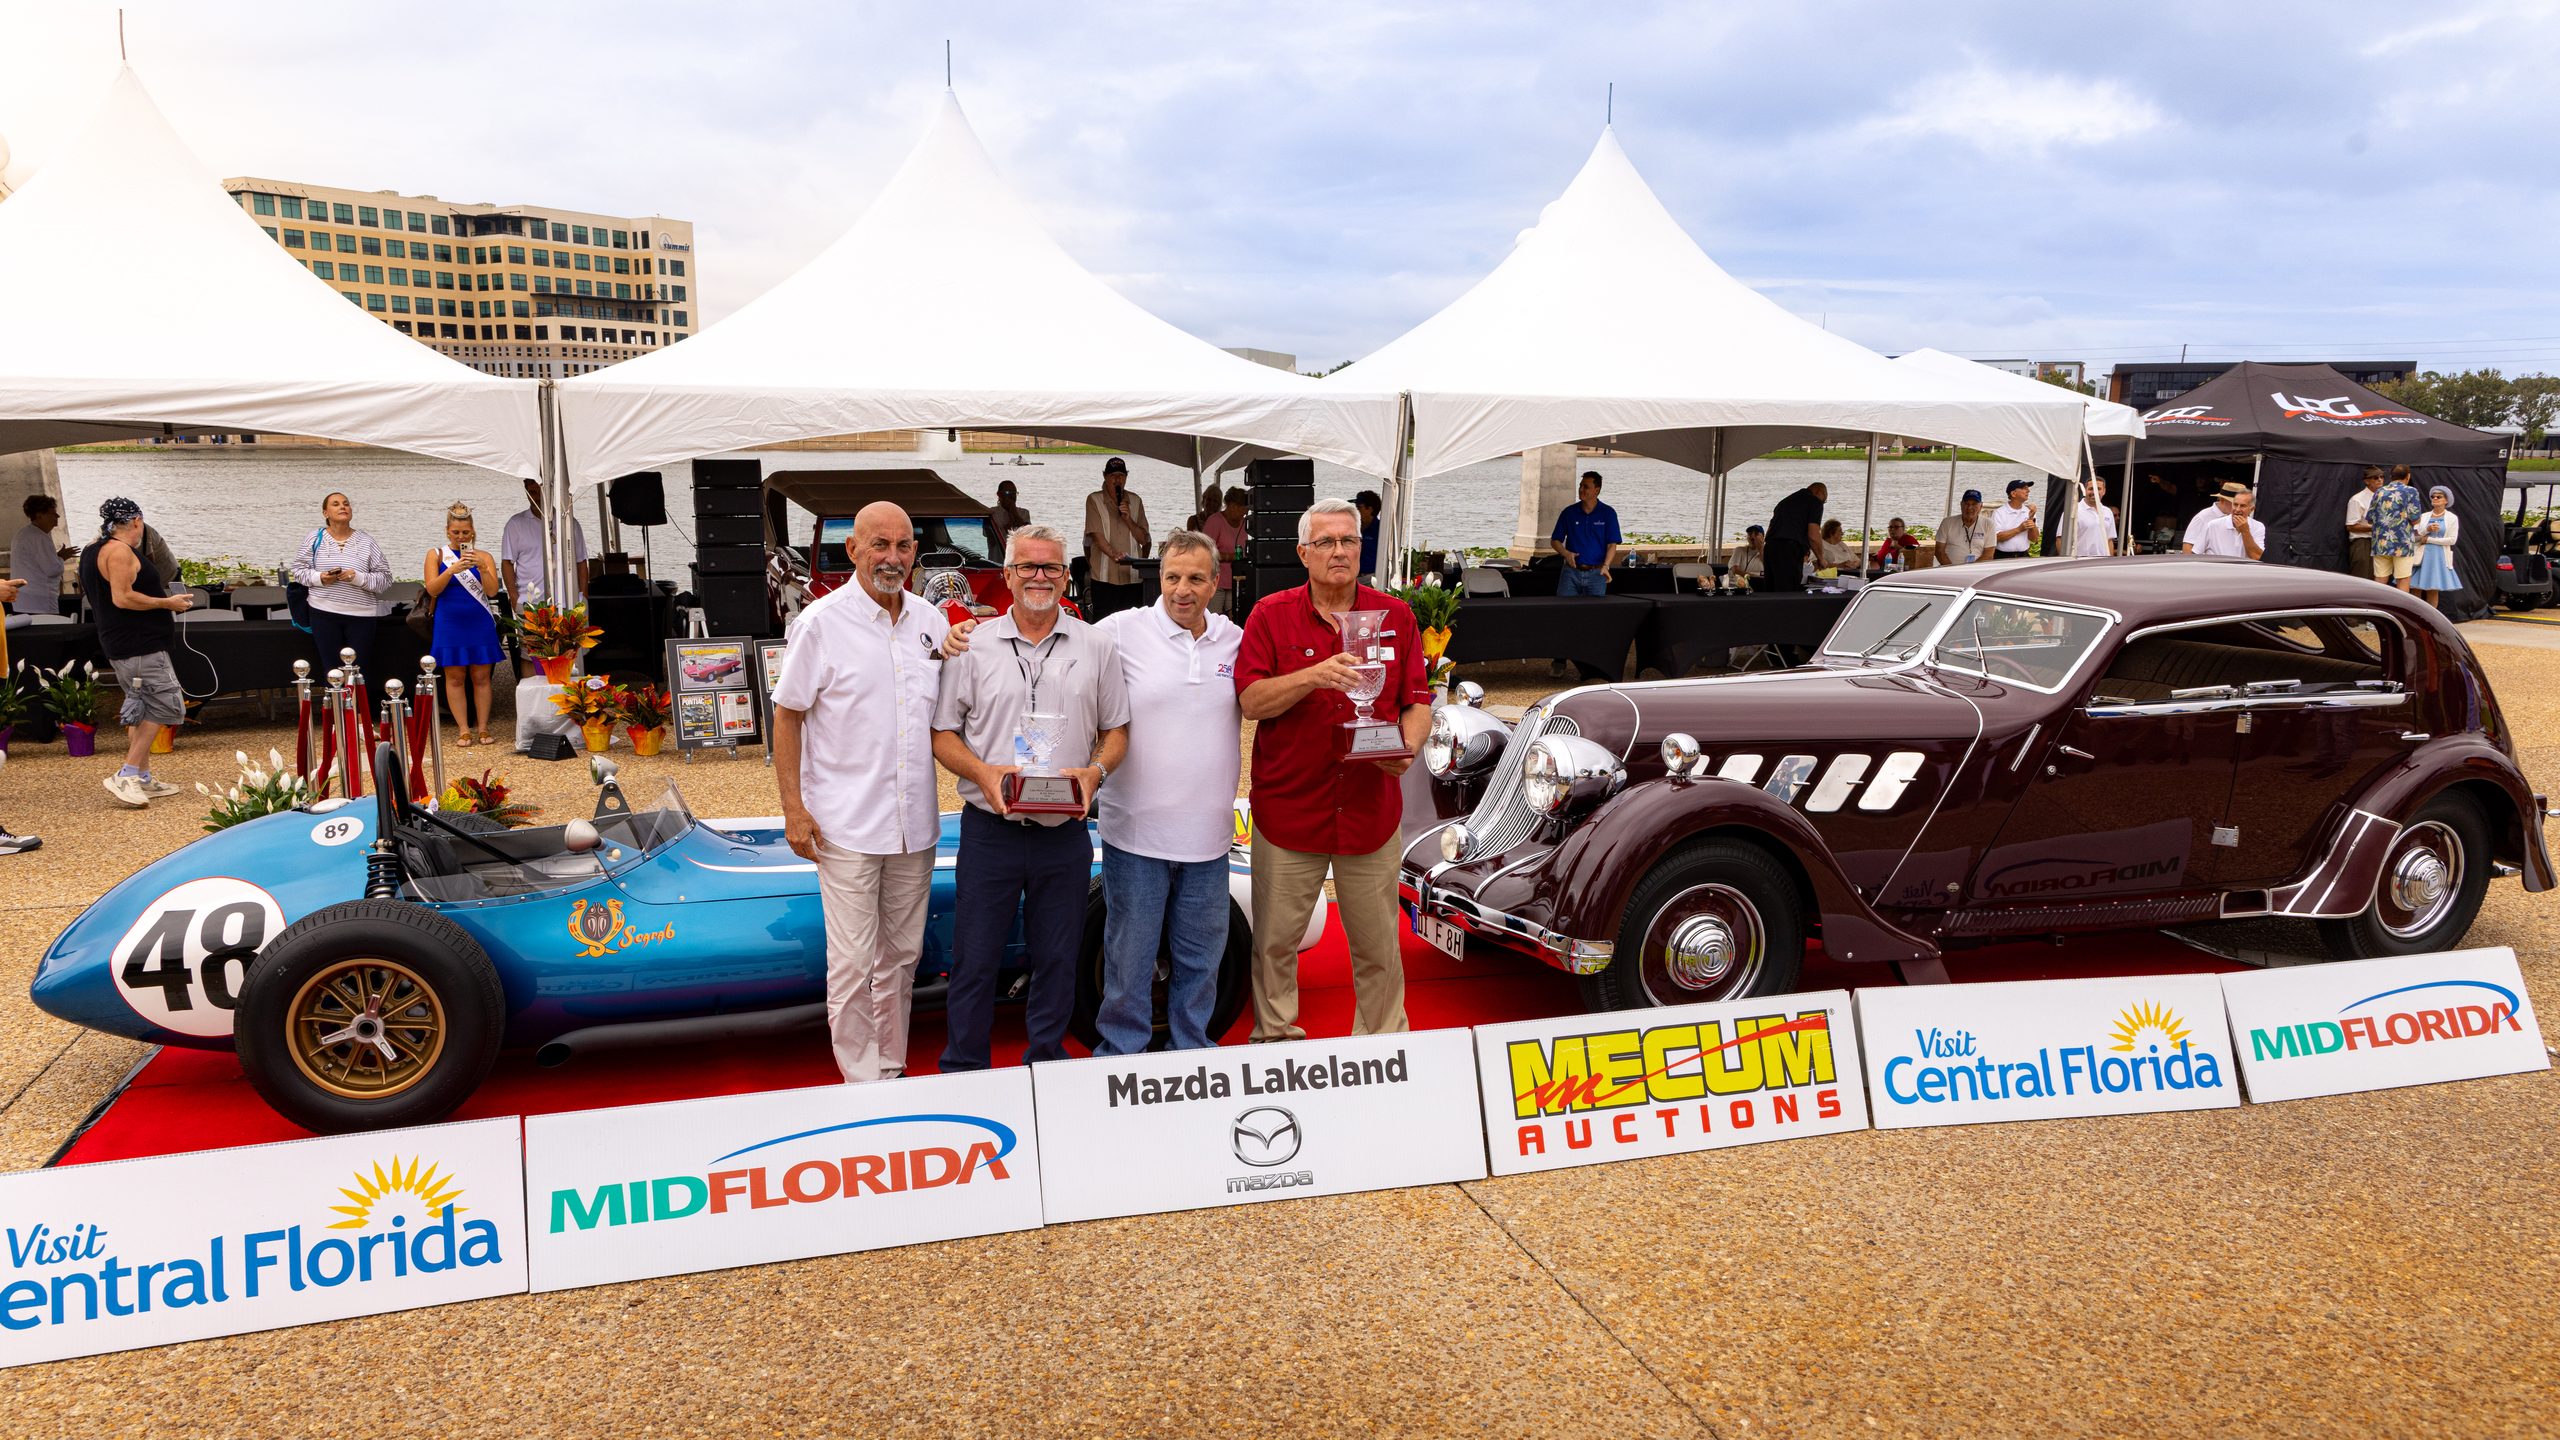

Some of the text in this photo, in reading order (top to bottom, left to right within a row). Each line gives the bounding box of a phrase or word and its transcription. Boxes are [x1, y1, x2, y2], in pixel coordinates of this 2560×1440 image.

[324, 821, 349, 841] 89
[121, 902, 267, 1013] 48
[618, 920, 676, 949] Scarab
[1446, 929, 1461, 957] 8H
[1915, 1028, 1978, 1059] Visit
[2250, 1002, 2523, 1062] MIDFLORIDA
[1107, 1049, 1409, 1108] Mazda Lakeland
[1506, 1009, 1837, 1120] MECUM
[1884, 1040, 2224, 1105] Central Florida
[1517, 1089, 1842, 1156] AUCTIONS
[549, 1140, 1010, 1234] MIDFLORIDA
[0, 1203, 503, 1331] entral Florida
[6, 1223, 108, 1268] Visit
